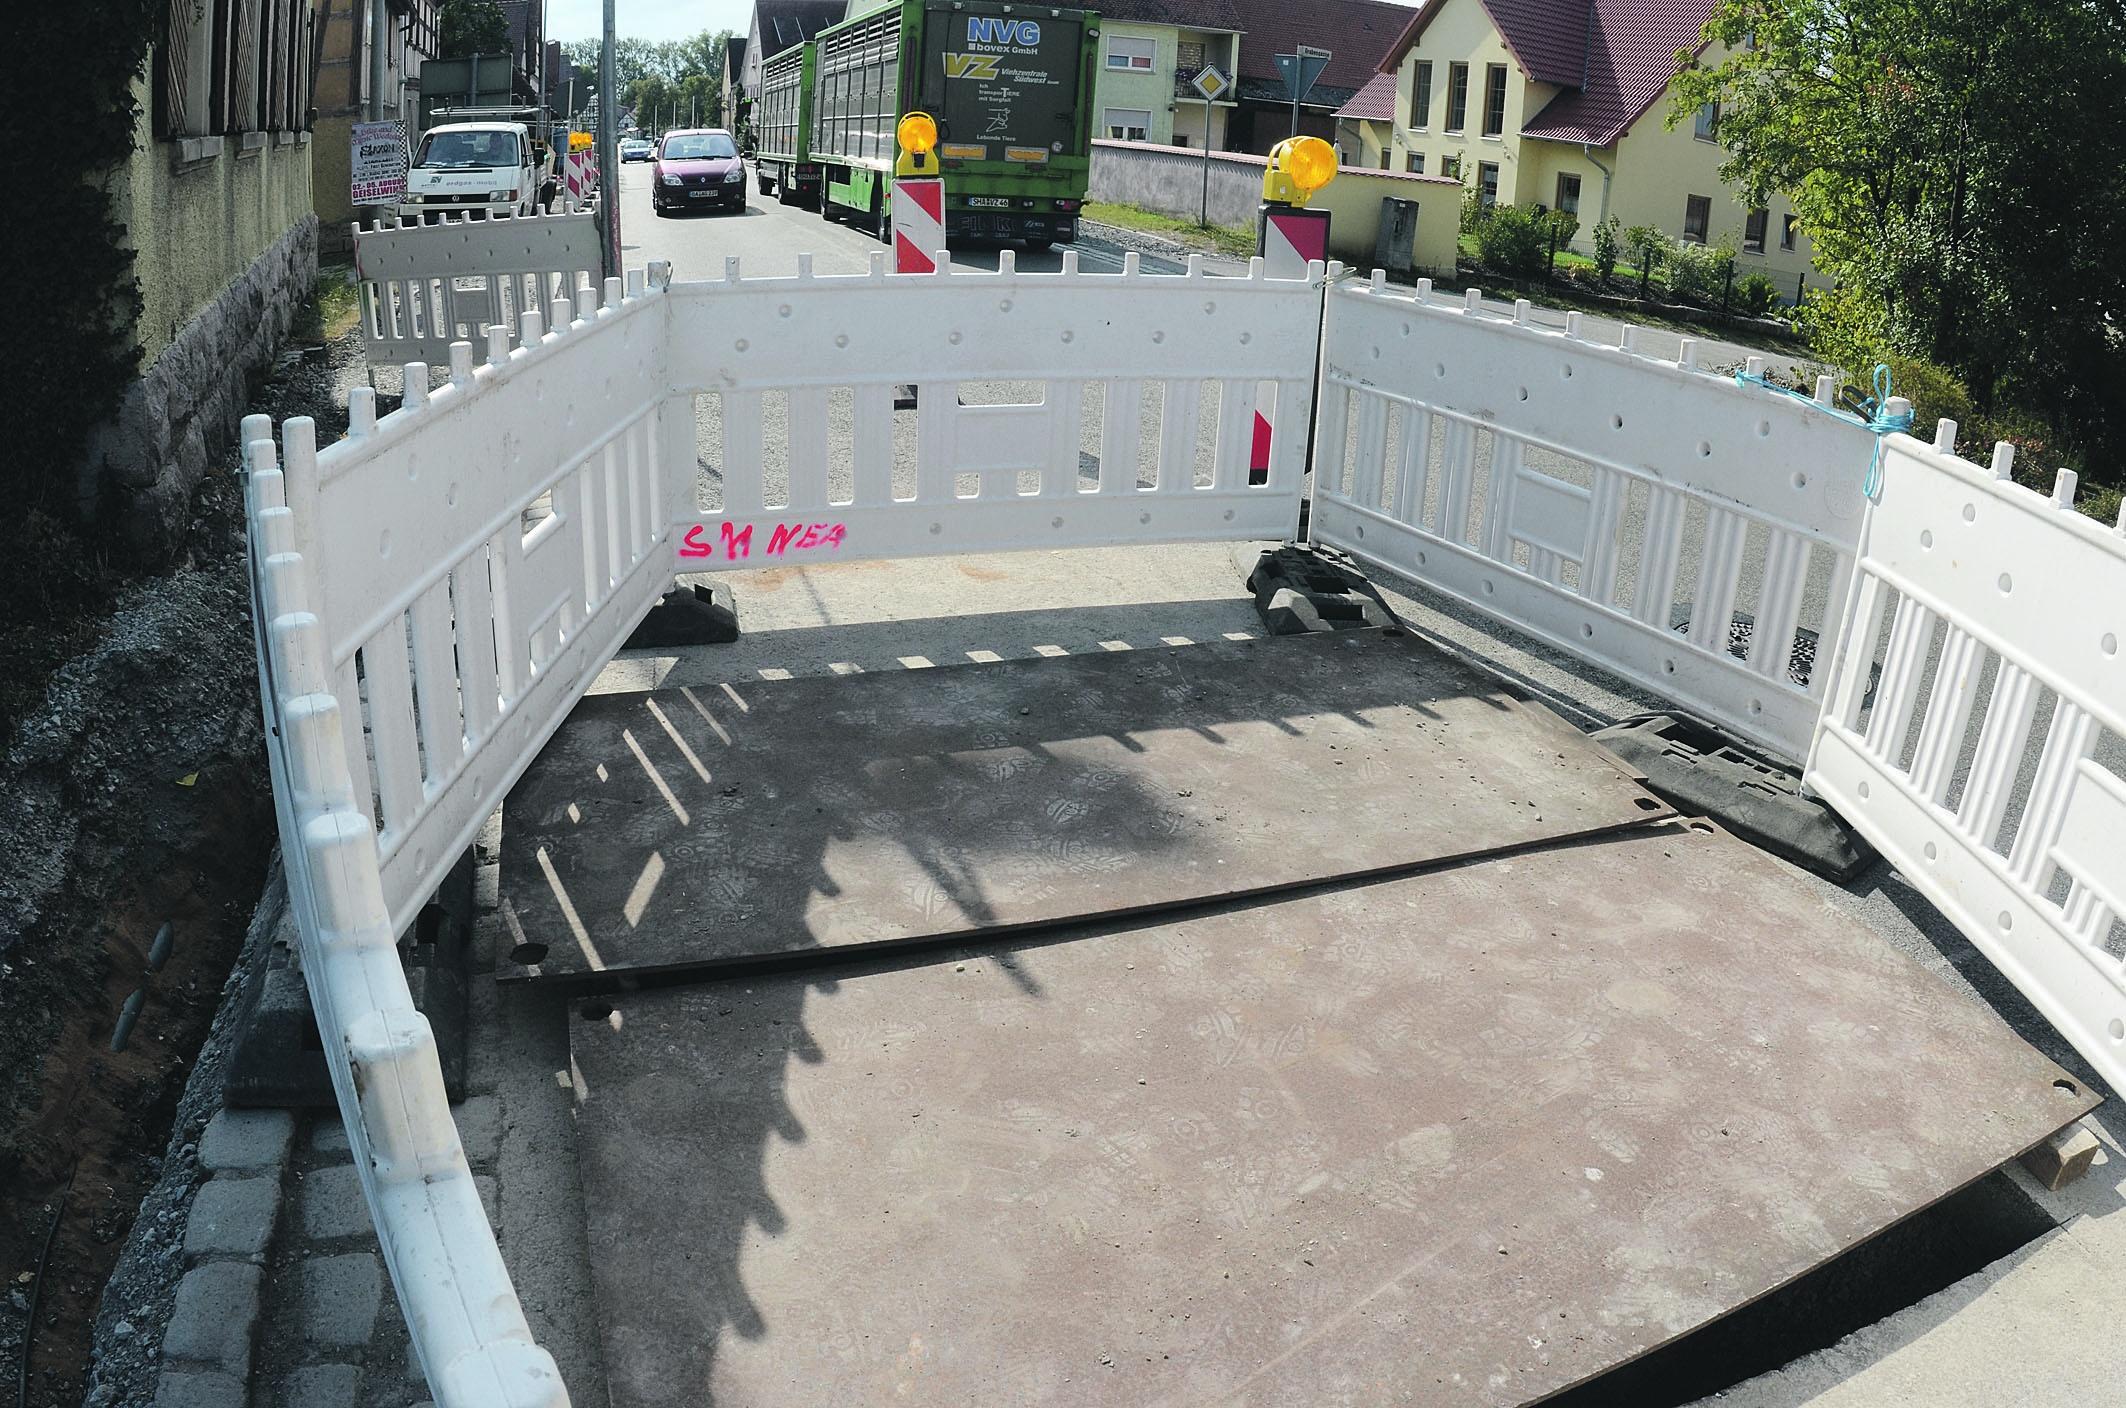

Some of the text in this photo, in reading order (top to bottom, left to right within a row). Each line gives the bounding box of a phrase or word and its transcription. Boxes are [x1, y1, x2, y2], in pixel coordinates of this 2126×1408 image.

[967, 16, 1041, 46] NVG
[976, 43, 1038, 55] bovex GmbH
[942, 52, 1004, 80] VZ
